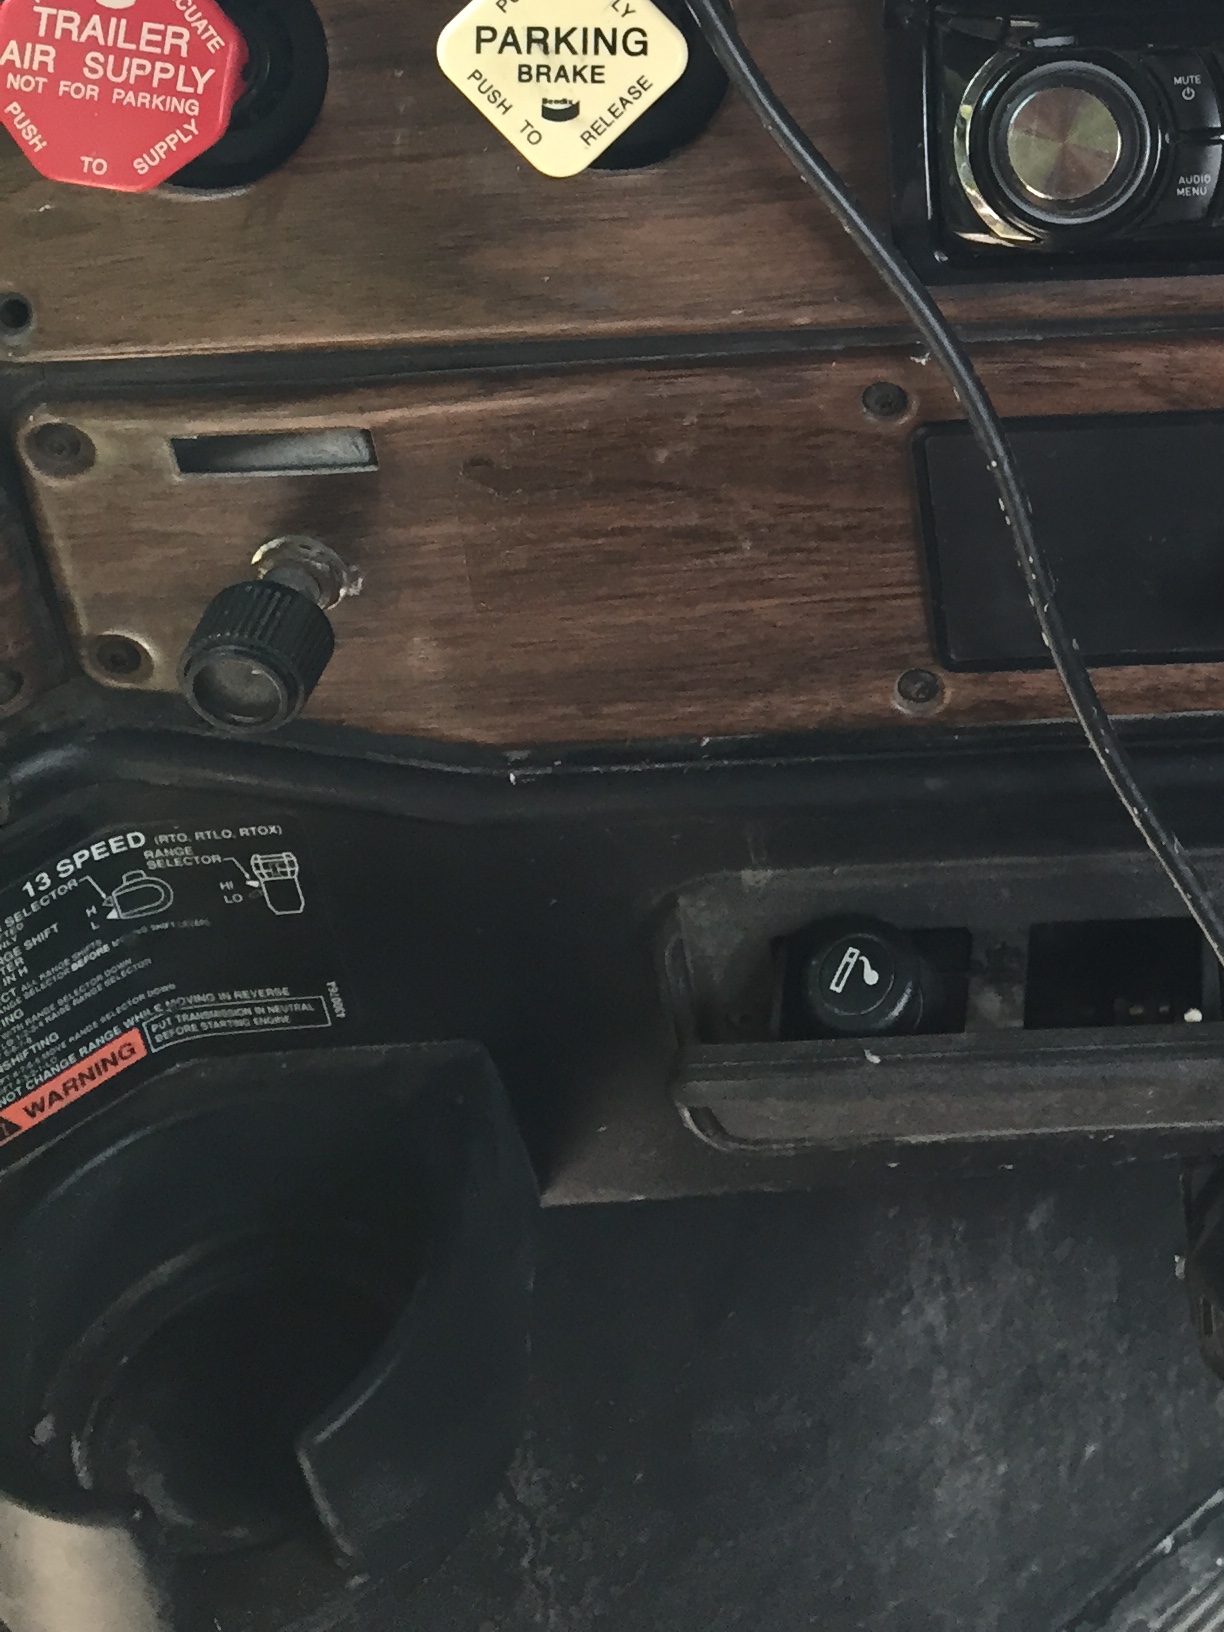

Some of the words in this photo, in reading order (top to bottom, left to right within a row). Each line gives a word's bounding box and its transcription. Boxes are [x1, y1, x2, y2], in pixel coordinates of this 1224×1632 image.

[33, 5, 190, 58] TRAILER
[475, 25, 648, 56] PARKING
[0, 40, 56, 72] AIR
[83, 51, 215, 95] SUPPLY
[517, 64, 606, 84] BRAKE
[1173, 75, 1201, 85] MUTE
[6, 72, 47, 94] NOT
[59, 80, 100, 101] FOR
[112, 88, 200, 116] PARKING
[467, 69, 513, 115] PUSH
[519, 119, 542, 146] TO
[579, 75, 653, 146] RELEASE
[4, 101, 47, 152] PUSH
[80, 155, 108, 175] TO
[133, 119, 199, 174] SUPPLY
[1177, 186, 1207, 196] MENU
[1178, 175, 1212, 184] AUDIO
[22, 872, 52, 898] 13
[56, 831, 146, 878] SPEED
[239, 824, 282, 837] RTOX)
[143, 846, 194, 859] RANGE
[146, 854, 222, 870] SELECTOR
[220, 881, 234, 891] HI
[224, 893, 243, 904] LO
[5, 878, 78, 928] SELECTOR
[86, 905, 97, 918] H
[24, 922, 58, 950] SHIFT
[91, 921, 100, 930] L
[71, 943, 110, 972] BEFORE
[3, 972, 16, 986] IN
[25, 1003, 56, 1026] RANGE
[104, 958, 132, 977] DOWN
[151, 1019, 173, 1033] PUT
[267, 1003, 315, 1015] NEUTRAL
[154, 1023, 199, 1043] BEFORE
[201, 1019, 251, 1031] STARTING
[26, 1053, 77, 1091] CHANGE
[79, 1025, 121, 1058] RANGE
[218, 991, 231, 1001] IN
[233, 987, 290, 1000] REVERSE
[22, 1040, 138, 1119] WARNING
